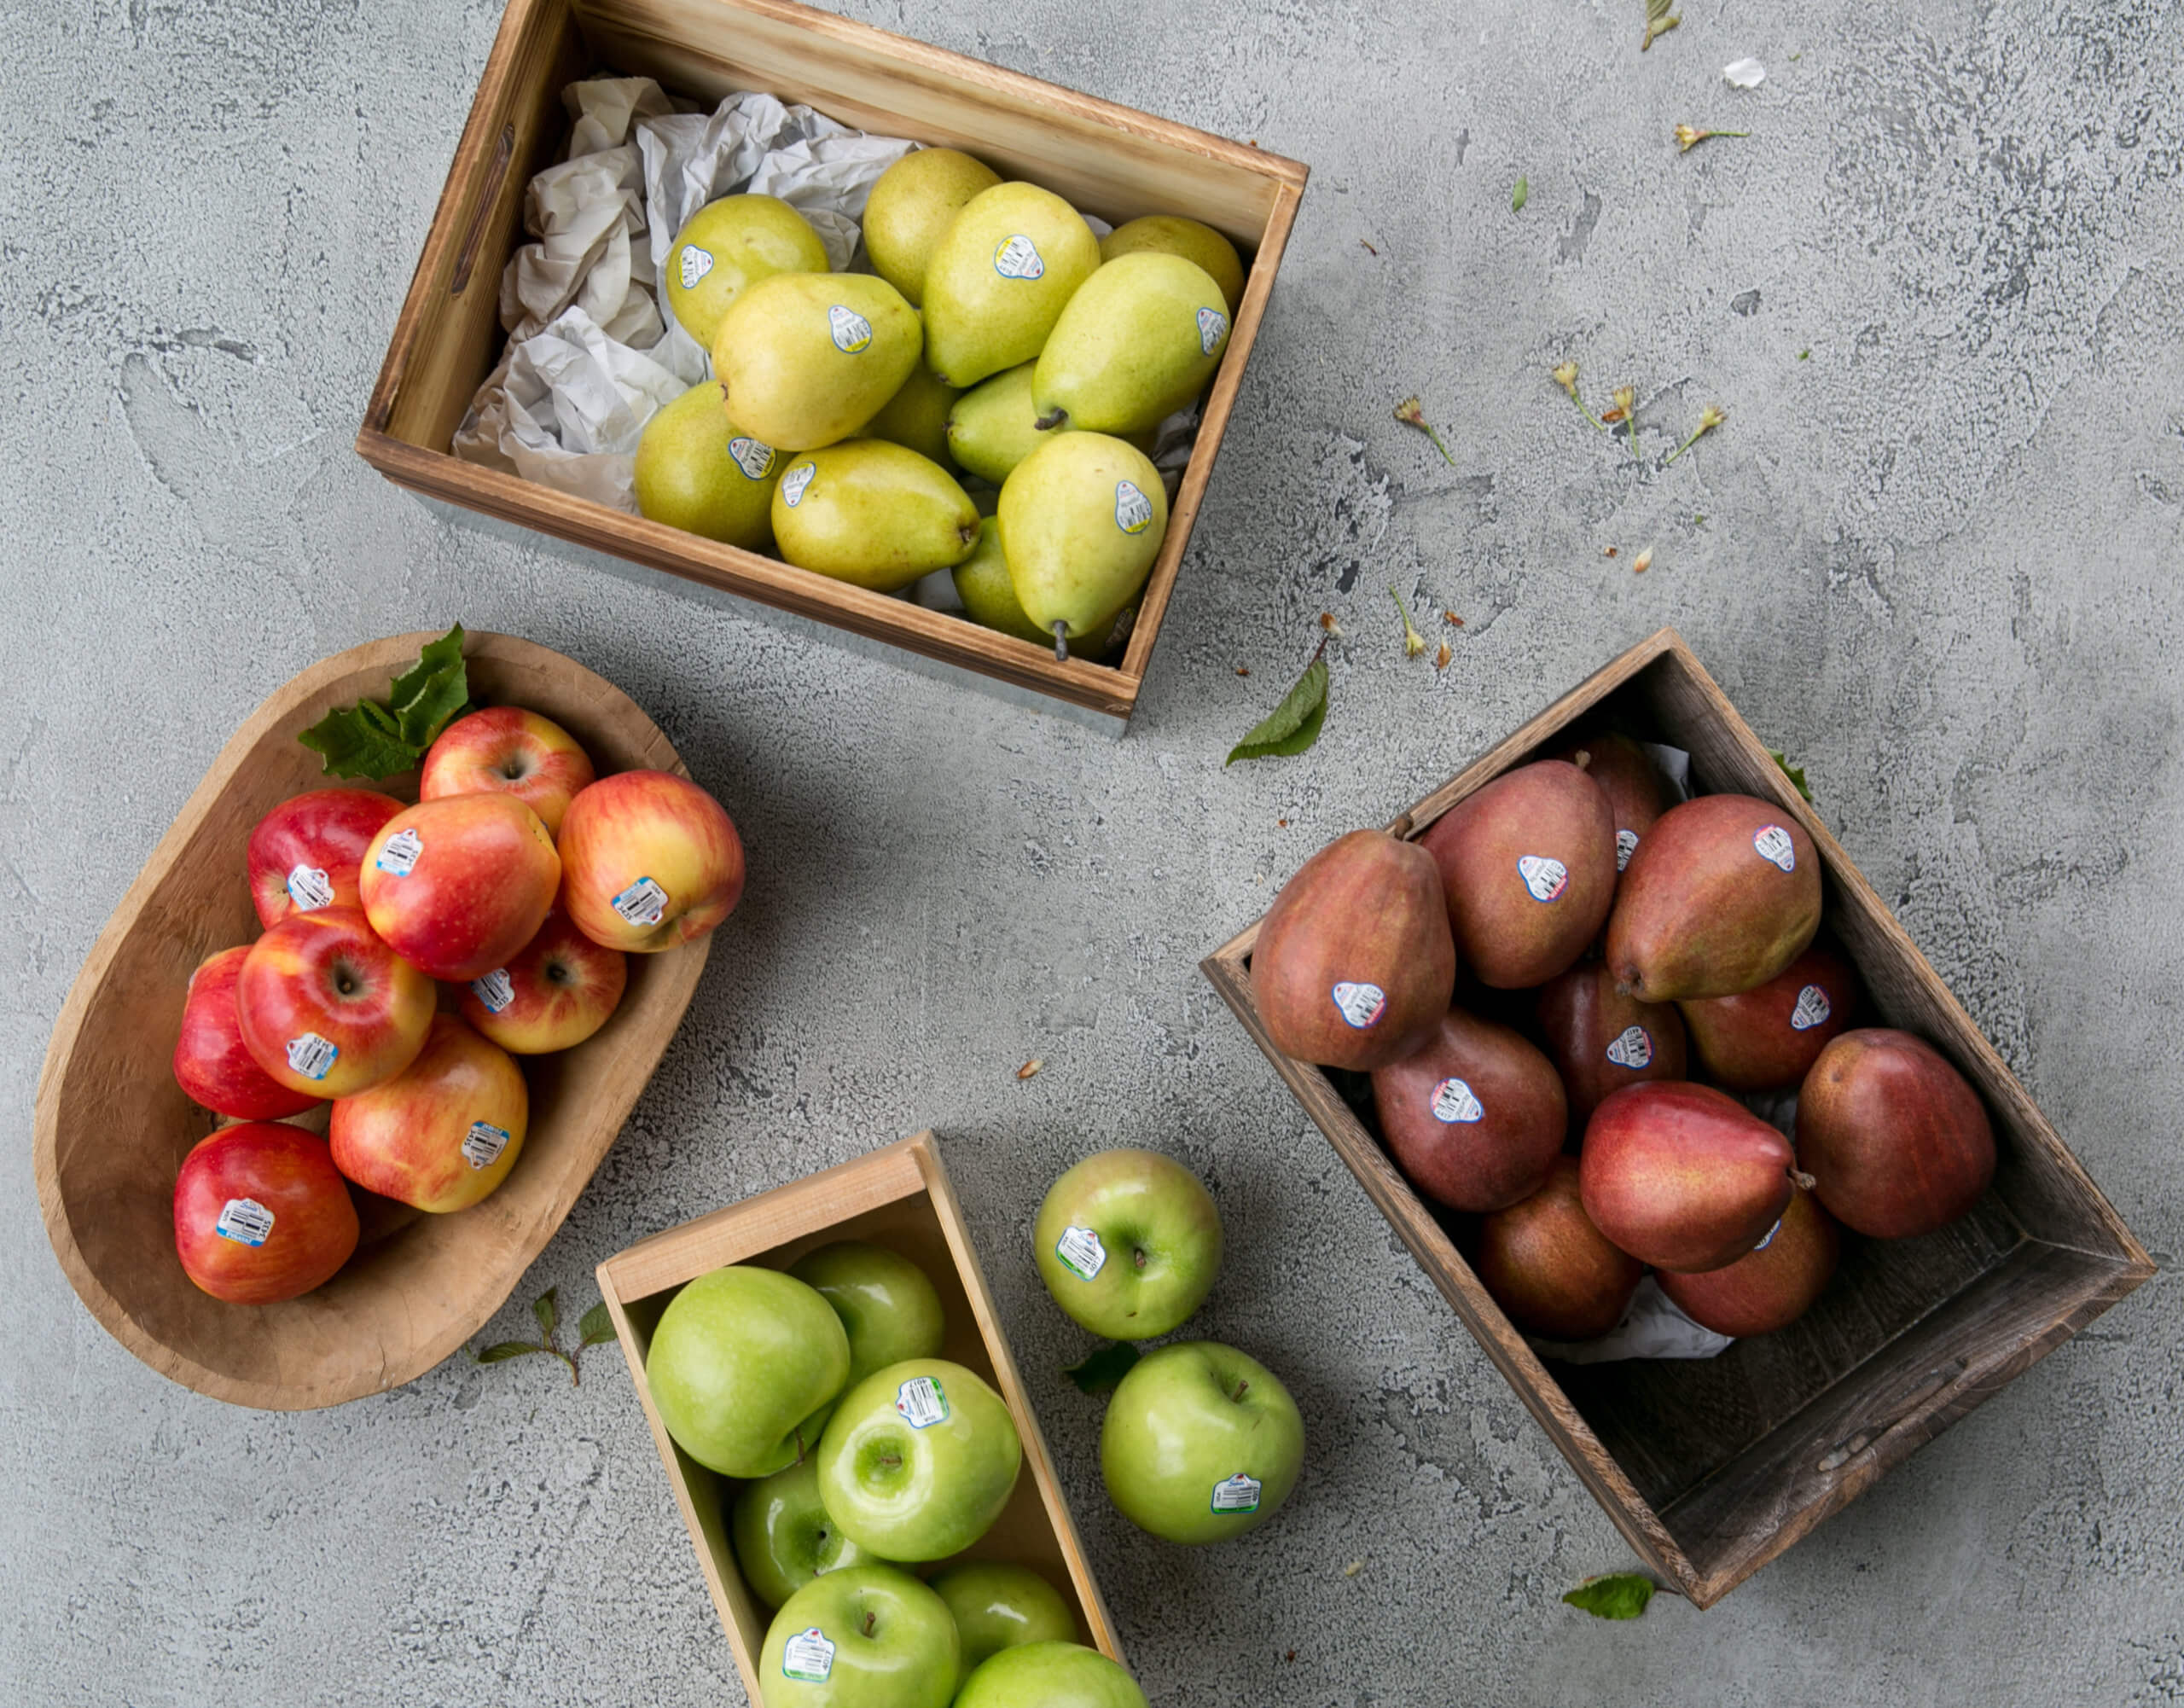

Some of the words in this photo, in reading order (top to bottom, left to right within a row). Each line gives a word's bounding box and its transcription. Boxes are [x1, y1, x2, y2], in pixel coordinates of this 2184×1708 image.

[406, 849, 417, 867] 3435
[617, 904, 631, 921] 3435
[1625, 1027, 1639, 1036] 4417
[312, 1037, 330, 1049] 3435
[464, 1129, 475, 1146] 3435
[259, 1220, 270, 1238] 3435
[909, 1379, 926, 1387] 4017
[1251, 1485, 1260, 1502] 4017
[822, 1650, 831, 1670] 4017
